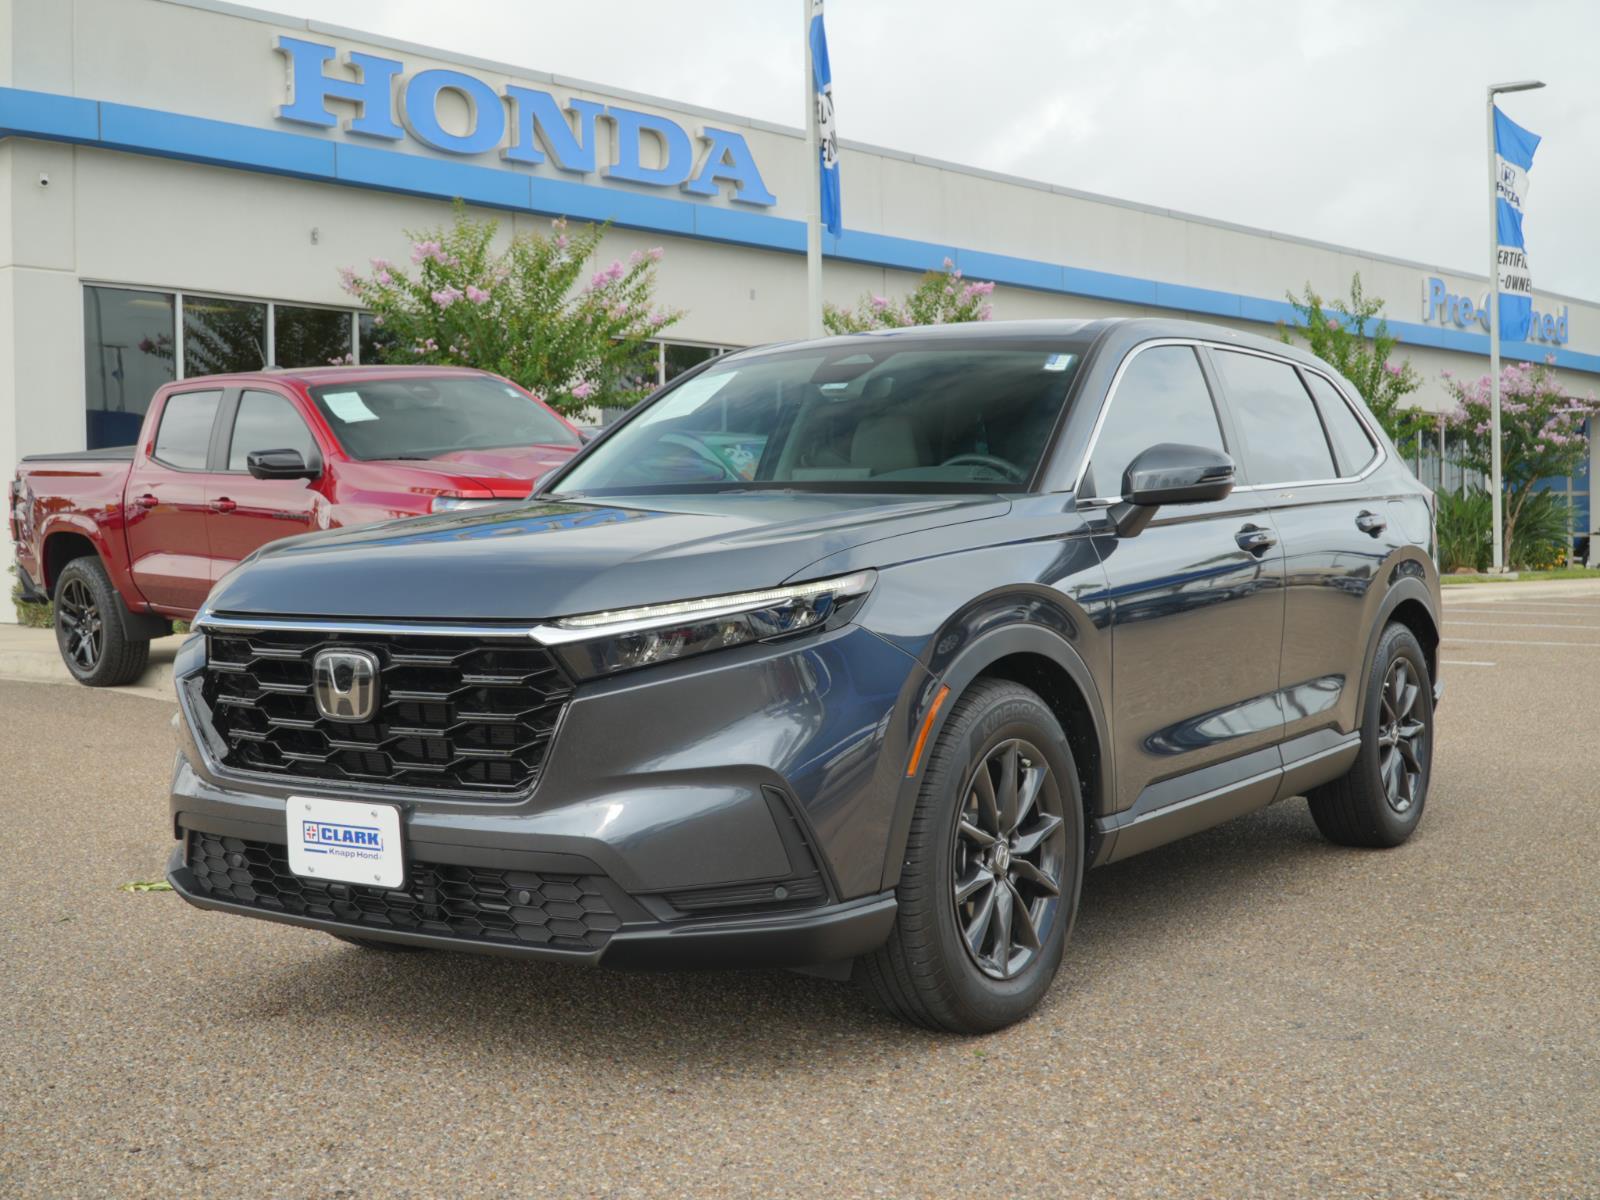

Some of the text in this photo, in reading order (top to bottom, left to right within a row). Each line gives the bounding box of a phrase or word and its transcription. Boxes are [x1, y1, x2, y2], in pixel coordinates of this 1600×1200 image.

[275, 35, 776, 206] HONDA
[1497, 250, 1528, 269] ERTIFI
[1425, 277, 1568, 344] Pre-ned
[321, 827, 379, 846] CLARK
[328, 848, 382, 860] Knapp Hond
